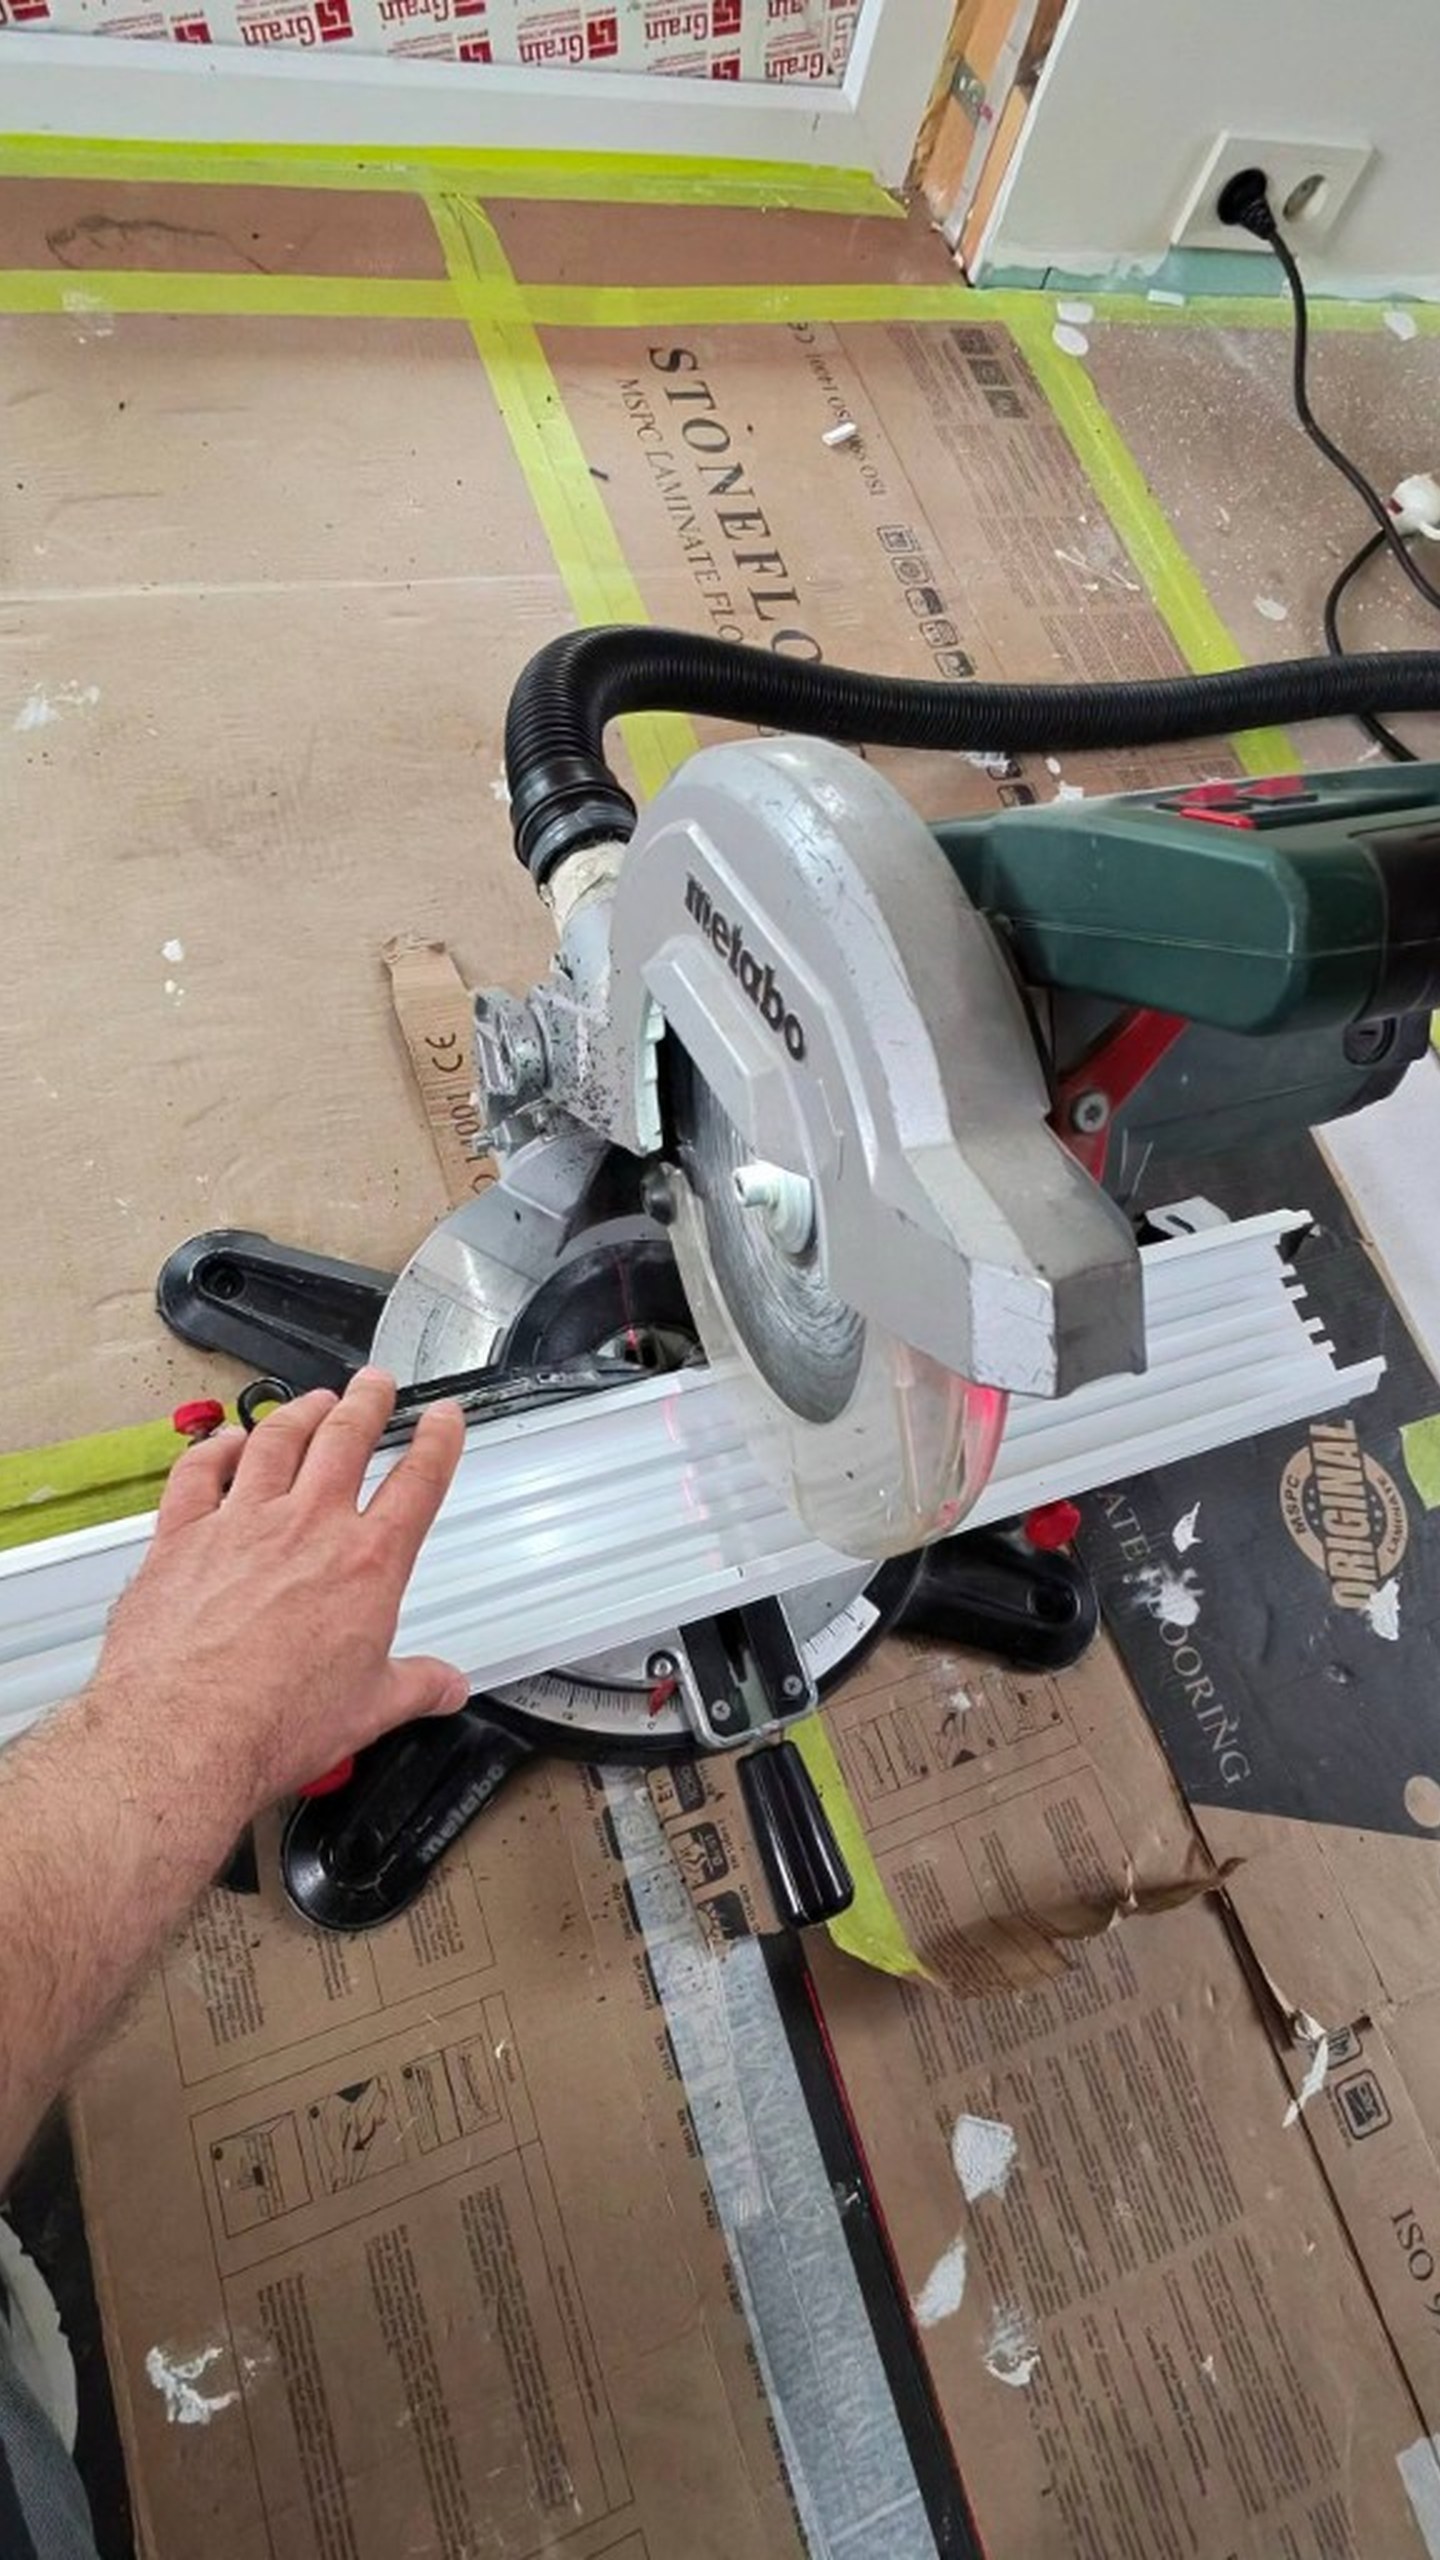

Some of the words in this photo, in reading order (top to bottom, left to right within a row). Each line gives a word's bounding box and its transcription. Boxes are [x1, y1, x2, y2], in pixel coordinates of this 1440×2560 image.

[242, 15, 316, 47] Grain
[518, 33, 586, 67] Grain
[645, 13, 708, 45] Grain
[765, 52, 824, 83] Grain
[615, 376, 663, 443] MSPC
[644, 449, 722, 584] LAMINATE
[649, 346, 823, 663] STONEFLO
[684, 871, 807, 1062] metabo
[424, 1032, 464, 1074] CE
[1283, 1473, 1307, 1535] MSPC
[1309, 1418, 1380, 1609] ORIGINAL
[416, 1763, 505, 1863] metabo
[1390, 2205, 1435, 2282] ISO
